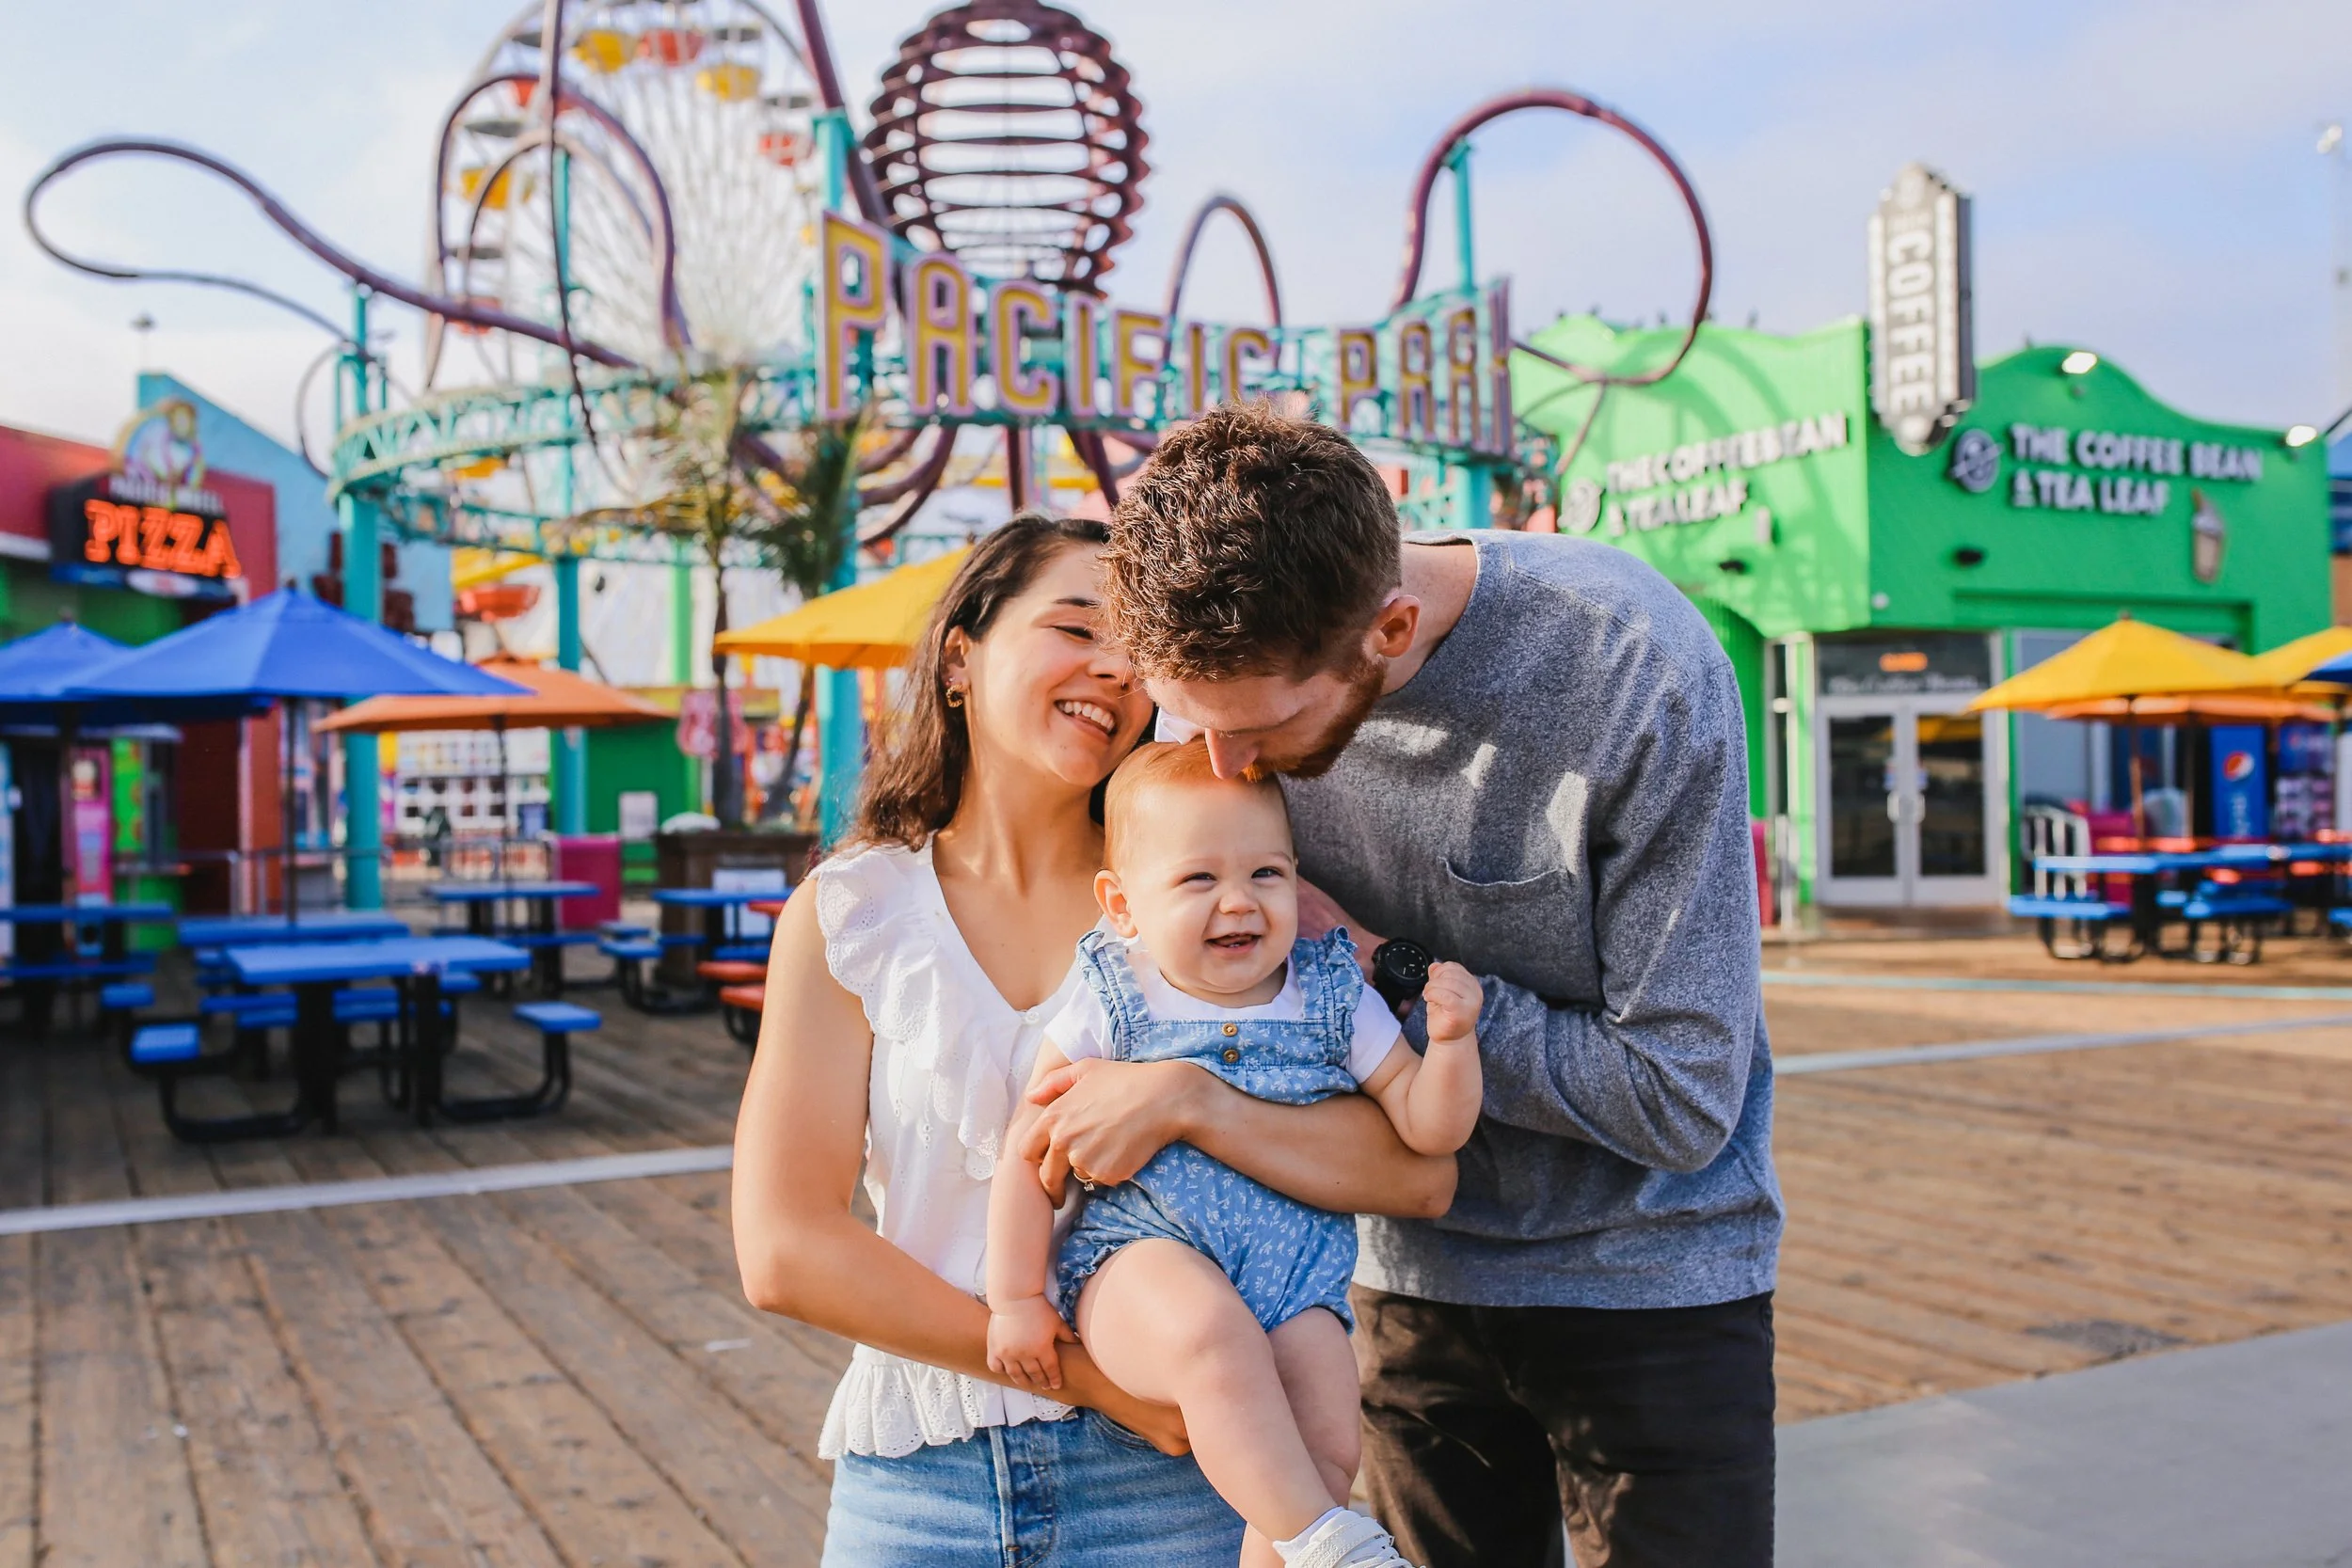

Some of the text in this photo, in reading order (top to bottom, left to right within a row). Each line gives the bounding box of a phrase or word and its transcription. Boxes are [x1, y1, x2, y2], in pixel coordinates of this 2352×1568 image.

[822, 209, 1274, 420] PACIFIC
[1887, 230, 1934, 416] COFFEE
[1607, 455, 1653, 495] THE
[2010, 421, 2265, 483] THE COFFEE BEAN
[2035, 470, 2095, 512] TEA
[2099, 475, 2171, 517] LEAF
[84, 499, 242, 579] PIZZA
